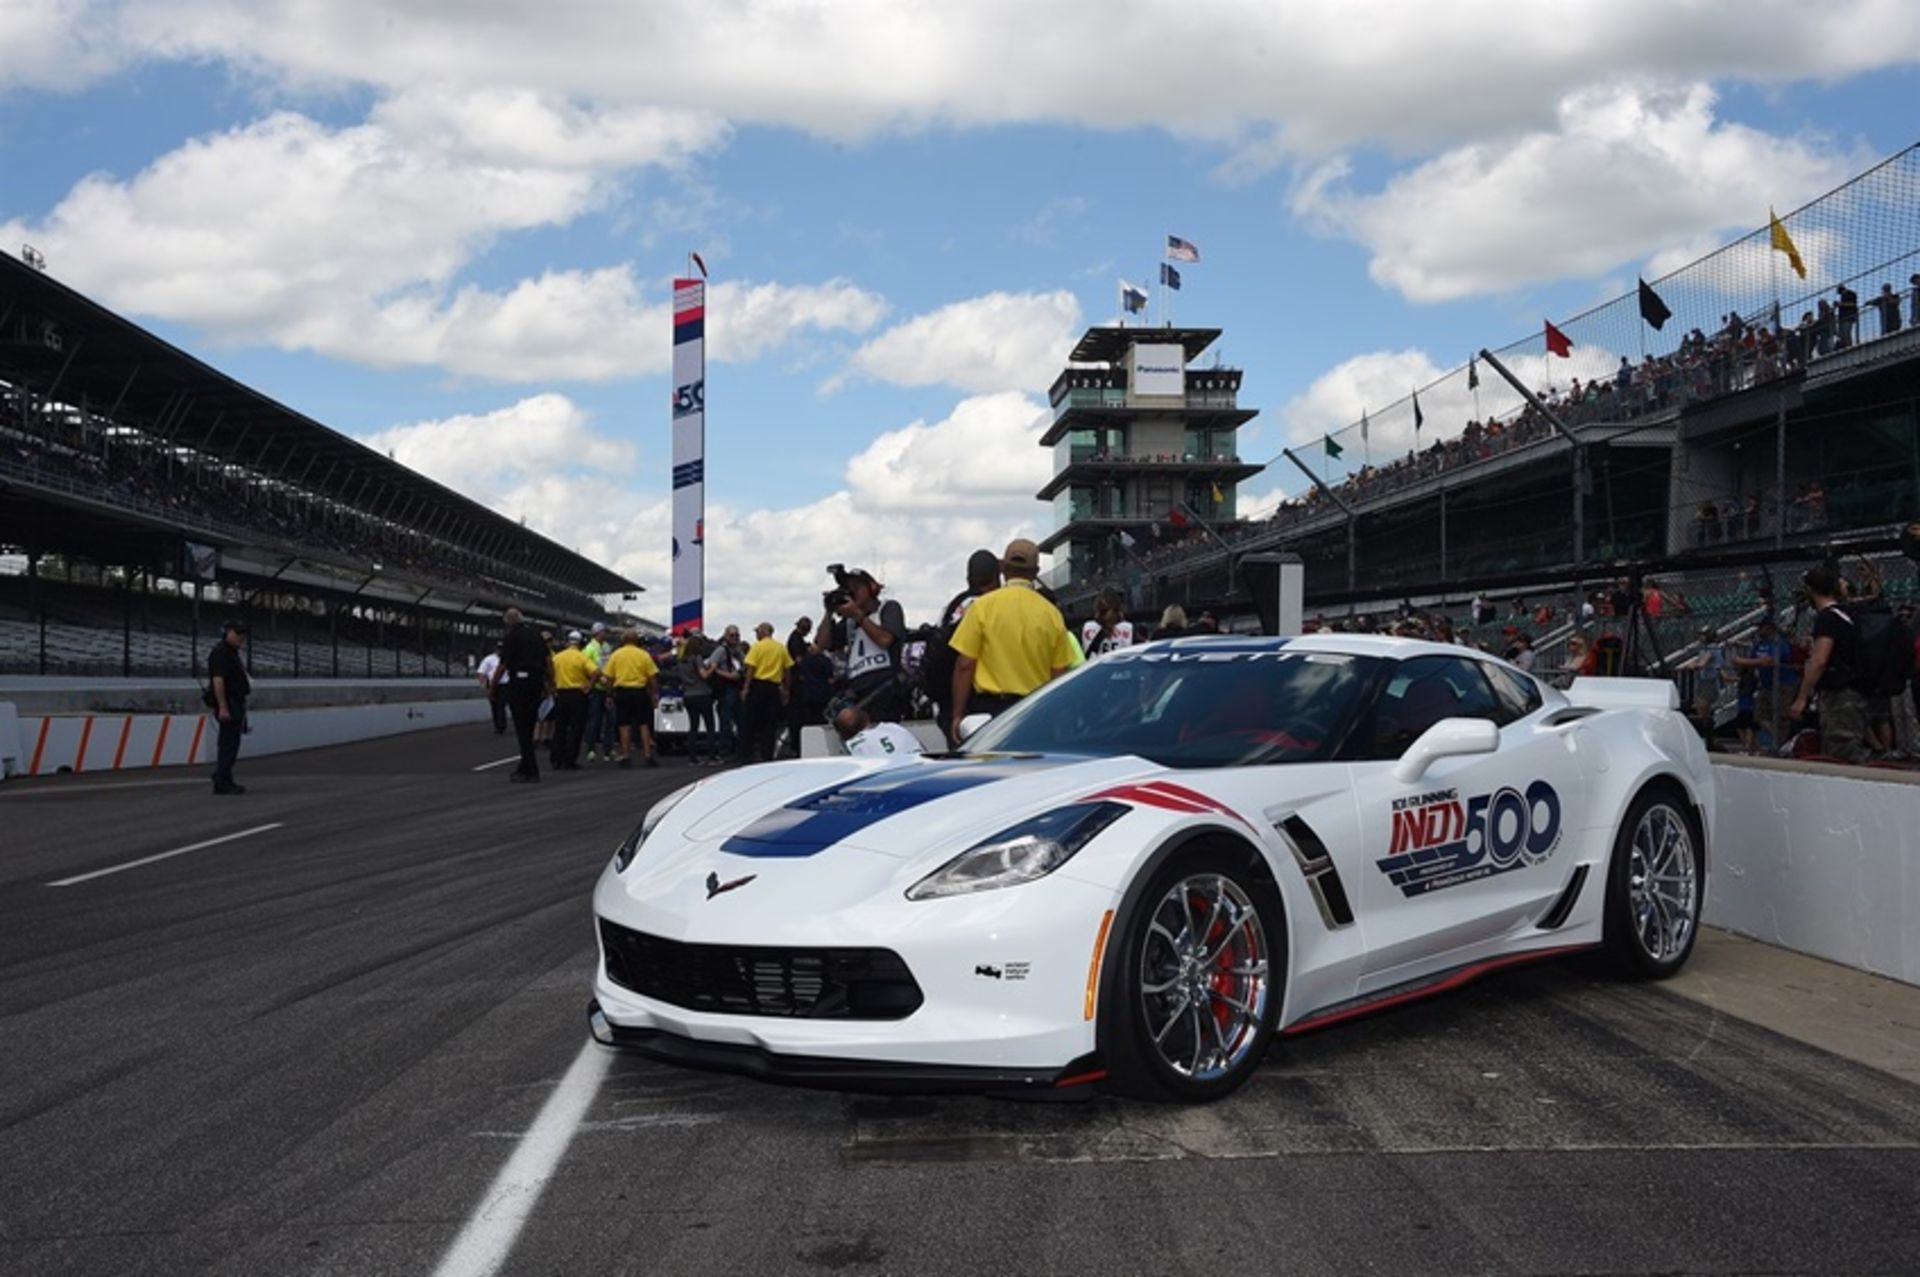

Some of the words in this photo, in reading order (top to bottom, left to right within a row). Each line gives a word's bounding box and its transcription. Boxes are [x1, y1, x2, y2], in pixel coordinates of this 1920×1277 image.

[1137, 366, 1179, 374] Panasonic
[879, 736, 895, 754] 5
[1390, 801, 1465, 855] INDY
[1465, 779, 1561, 867] 500
